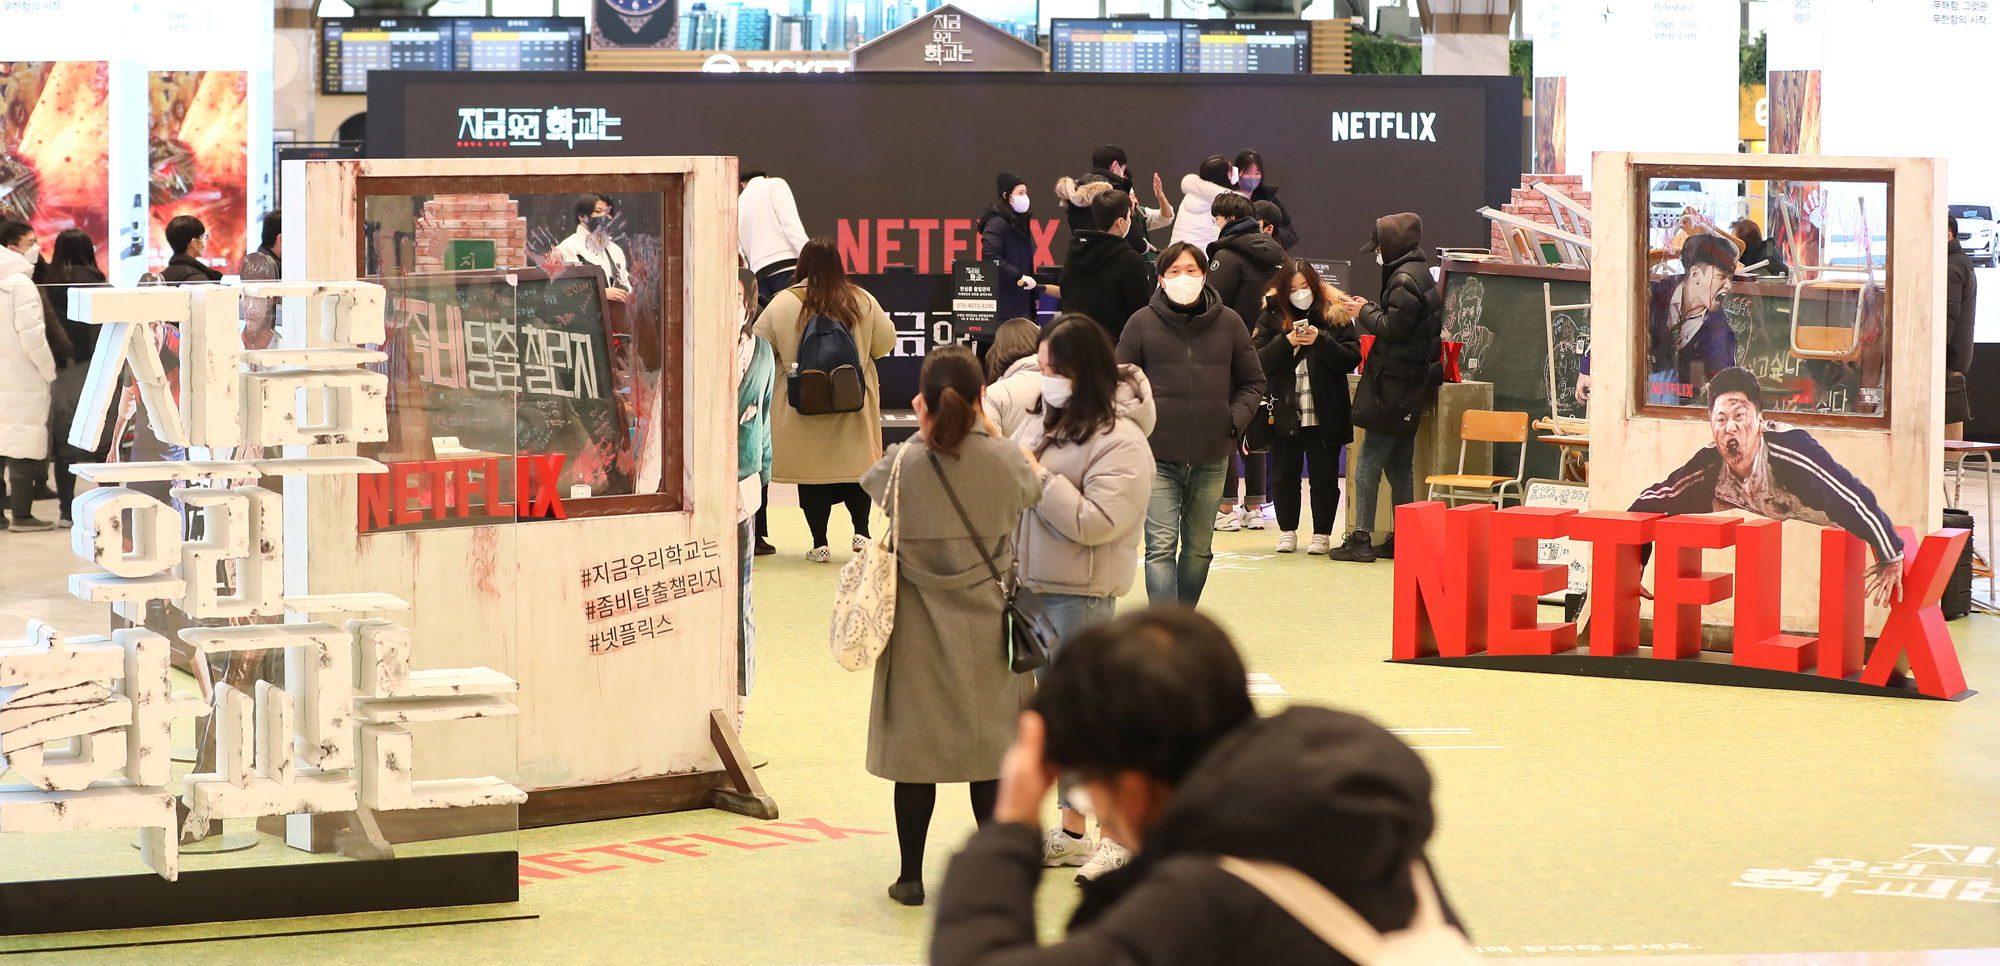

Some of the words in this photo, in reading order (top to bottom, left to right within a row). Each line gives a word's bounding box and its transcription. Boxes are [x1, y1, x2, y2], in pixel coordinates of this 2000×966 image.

[933, 14, 961, 29] 지금
[933, 31, 952, 43] 우리
[924, 43, 974, 66] 학교는
[457, 107, 507, 140] 지금
[507, 108, 543, 146] 우리
[545, 105, 623, 150] 학교는
[1331, 111, 1437, 143] NETFLIX
[837, 218, 1061, 275] NETFX
[67, 281, 389, 453] 지금
[1651, 382, 1694, 398] NETFLIX
[357, 453, 569, 533] NETFLIX
[581, 538, 719, 588] #지금우리학교는
[585, 566, 723, 621] #좀비탈출챌린지
[1392, 500, 1971, 700] NETFLIX
[589, 614, 674, 653] #넷플릭스
[0, 617, 528, 882] 학교는
[518, 818, 892, 886] NETFLIX
[1901, 843, 2000, 866] 지
